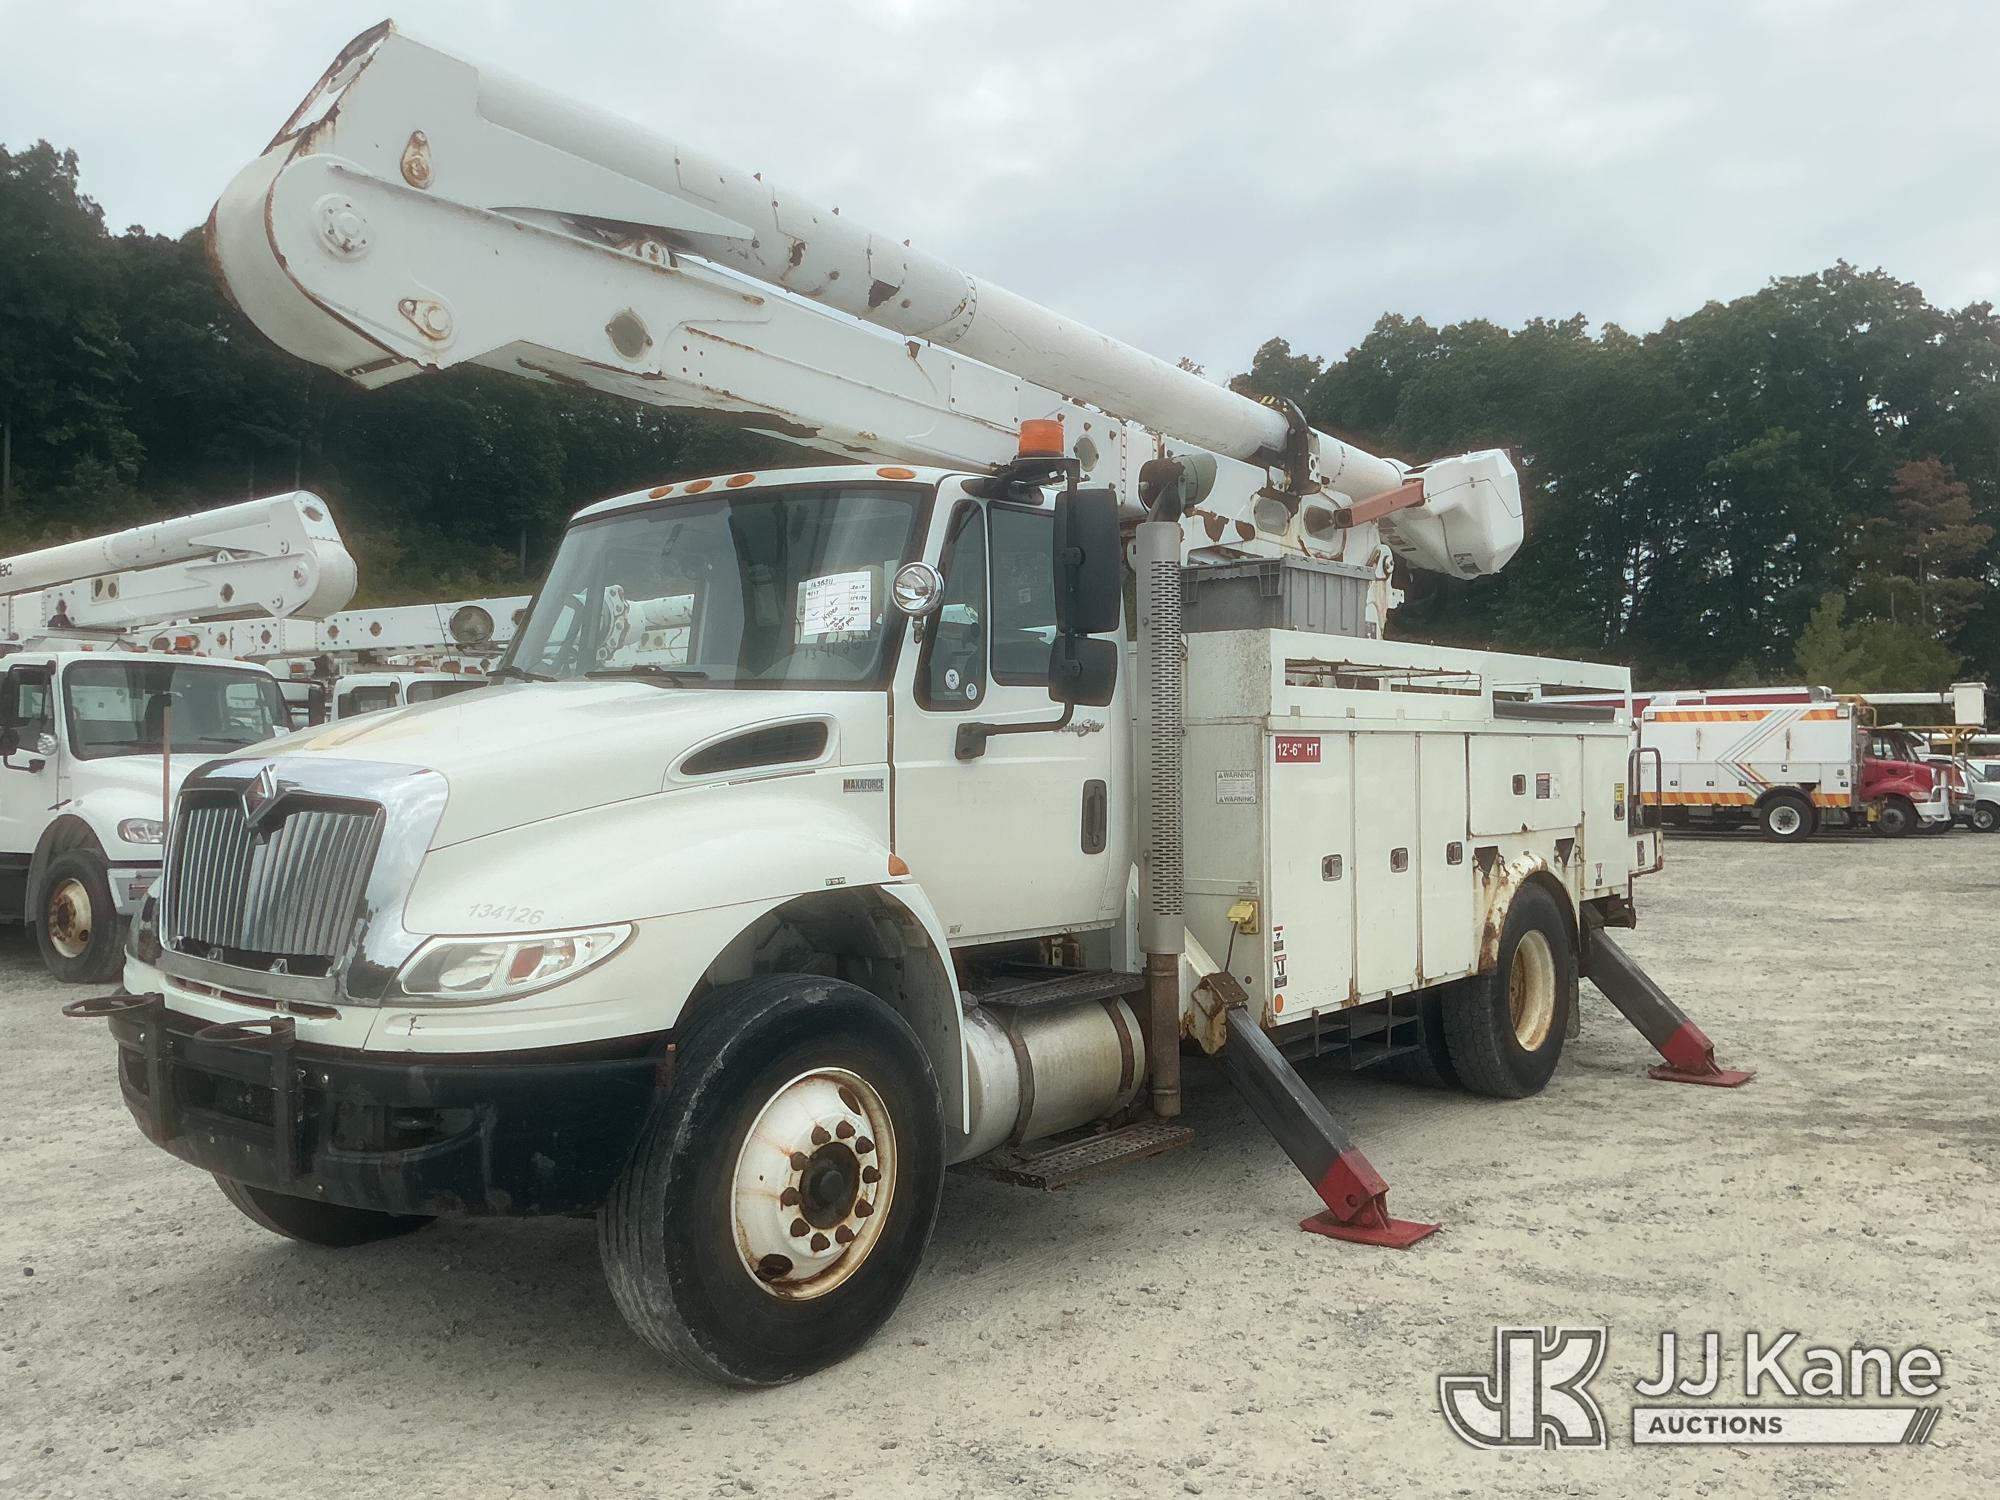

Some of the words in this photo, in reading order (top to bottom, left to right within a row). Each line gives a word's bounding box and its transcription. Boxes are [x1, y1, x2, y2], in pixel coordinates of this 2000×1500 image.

[1278, 743, 1302, 757] 12'-6"
[1307, 743, 1319, 757] HT
[1223, 771, 1254, 779] WARNING
[843, 779, 884, 790] MAXXFORCE
[1224, 796, 1255, 804] WARNING
[468, 903, 545, 925] 134126
